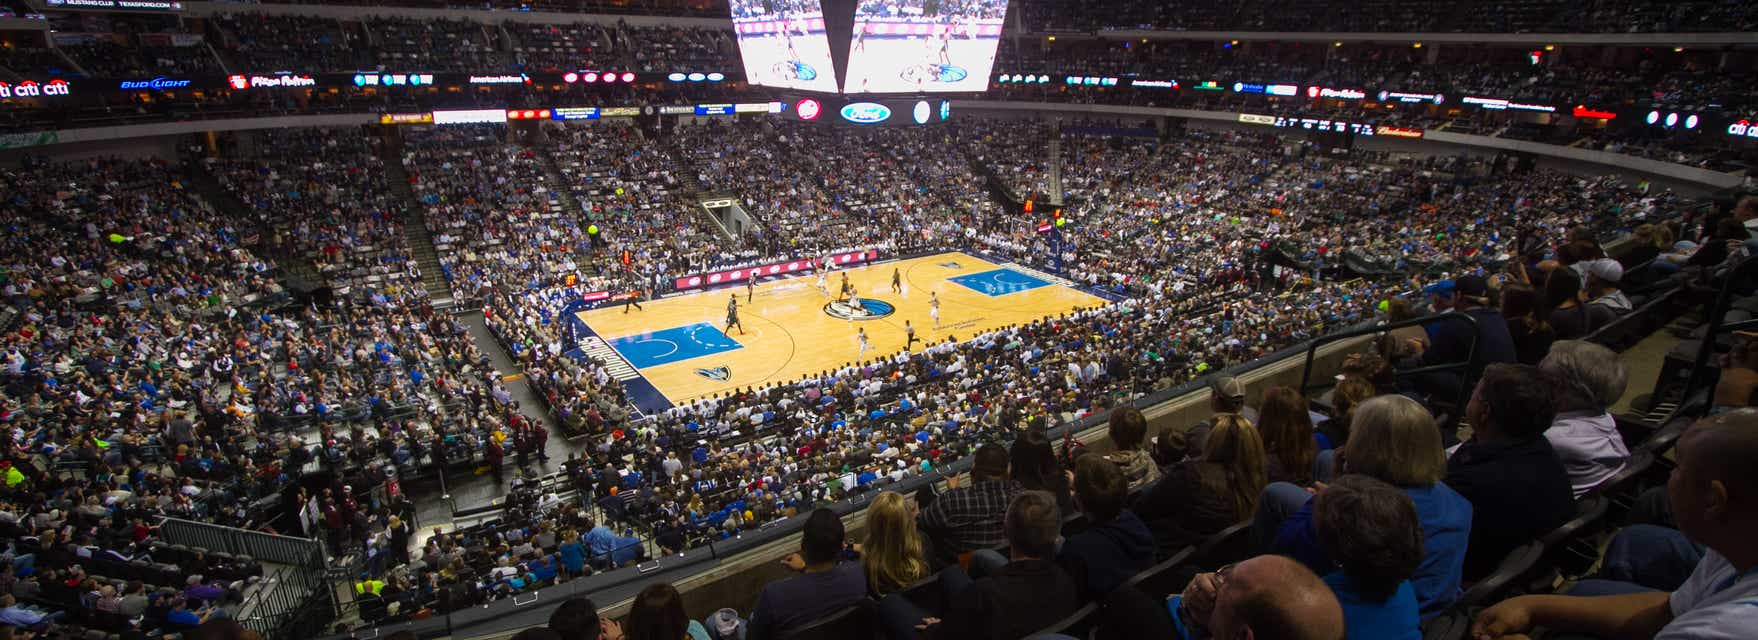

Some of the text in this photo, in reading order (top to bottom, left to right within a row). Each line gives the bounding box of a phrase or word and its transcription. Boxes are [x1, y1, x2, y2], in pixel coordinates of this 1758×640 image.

[14, 82, 40, 96] citi
[43, 82, 69, 95] citi
[154, 79, 190, 89] LIGHT
[1728, 122, 1746, 135] citi
